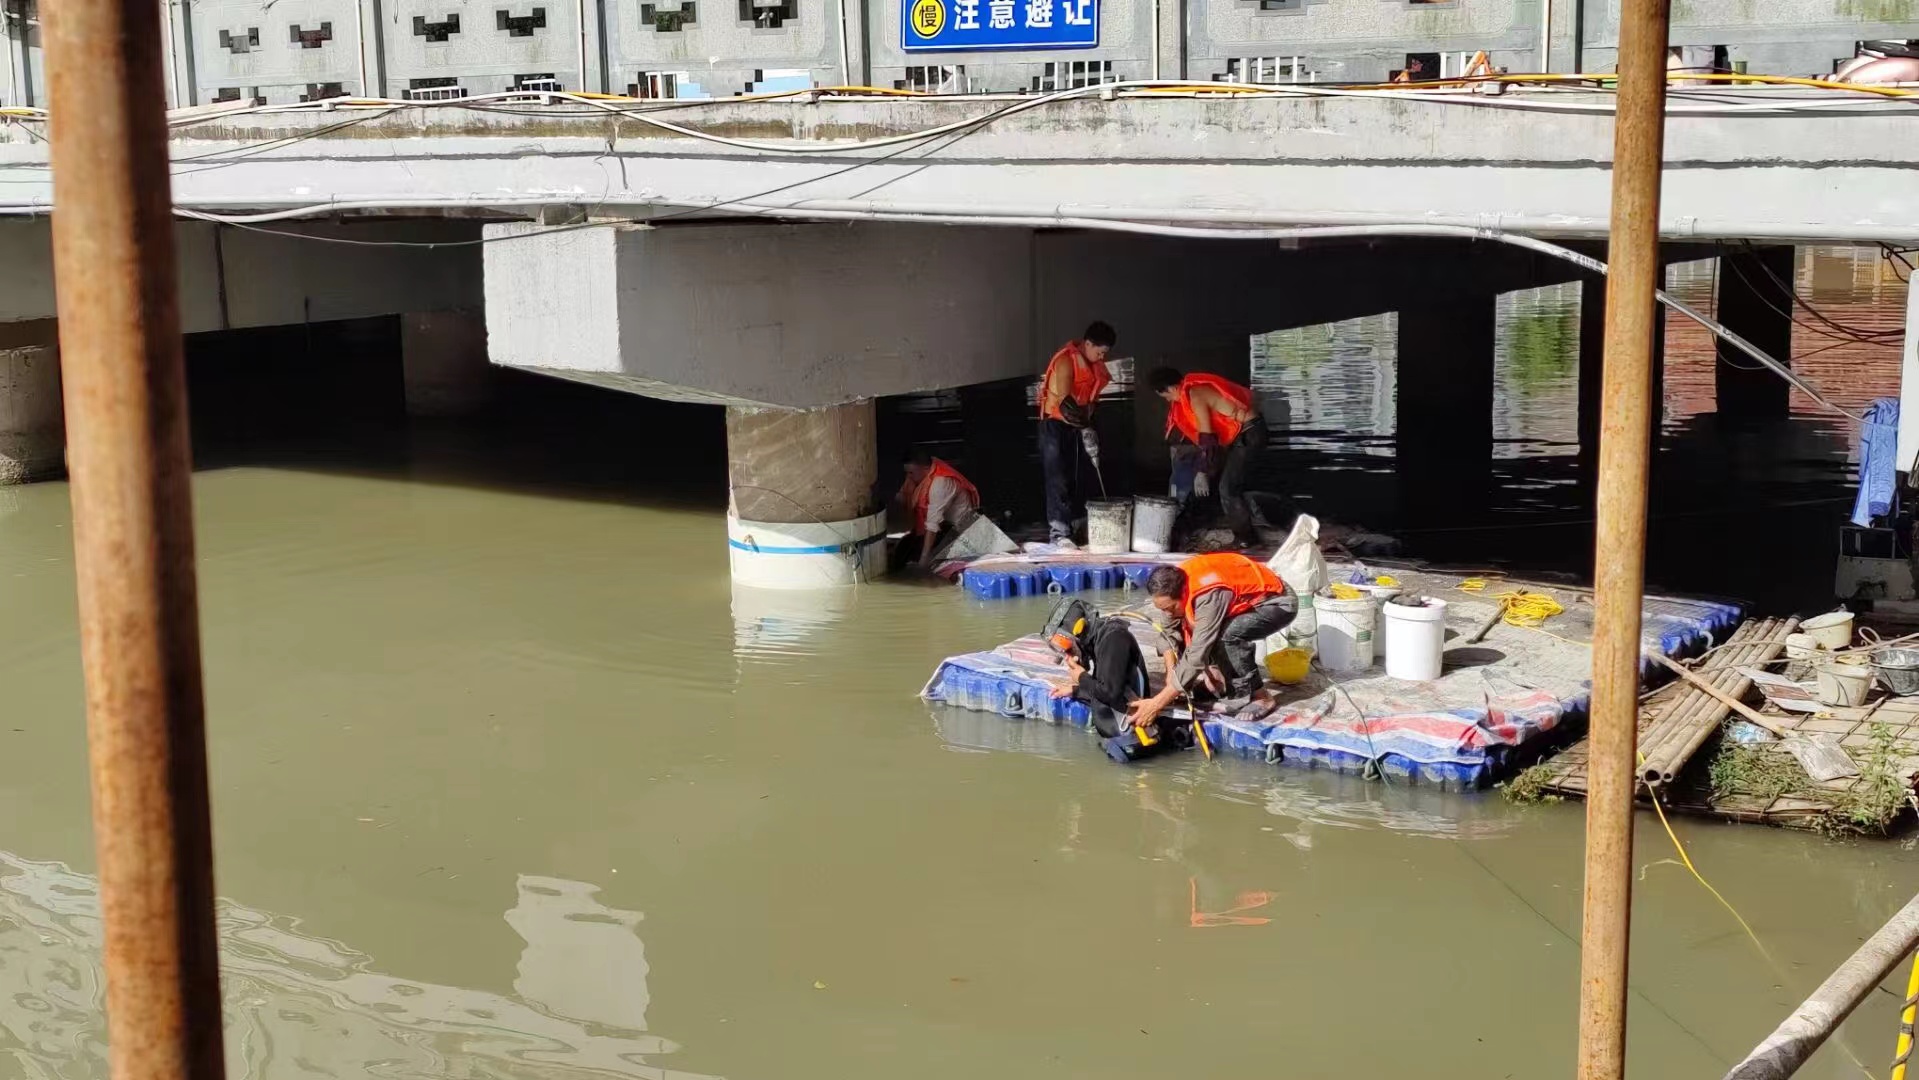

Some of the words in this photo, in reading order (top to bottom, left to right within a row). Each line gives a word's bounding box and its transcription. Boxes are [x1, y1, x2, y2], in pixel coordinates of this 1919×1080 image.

[919, 5, 937, 28] 慢
[954, 0, 1091, 30] 注意避让
